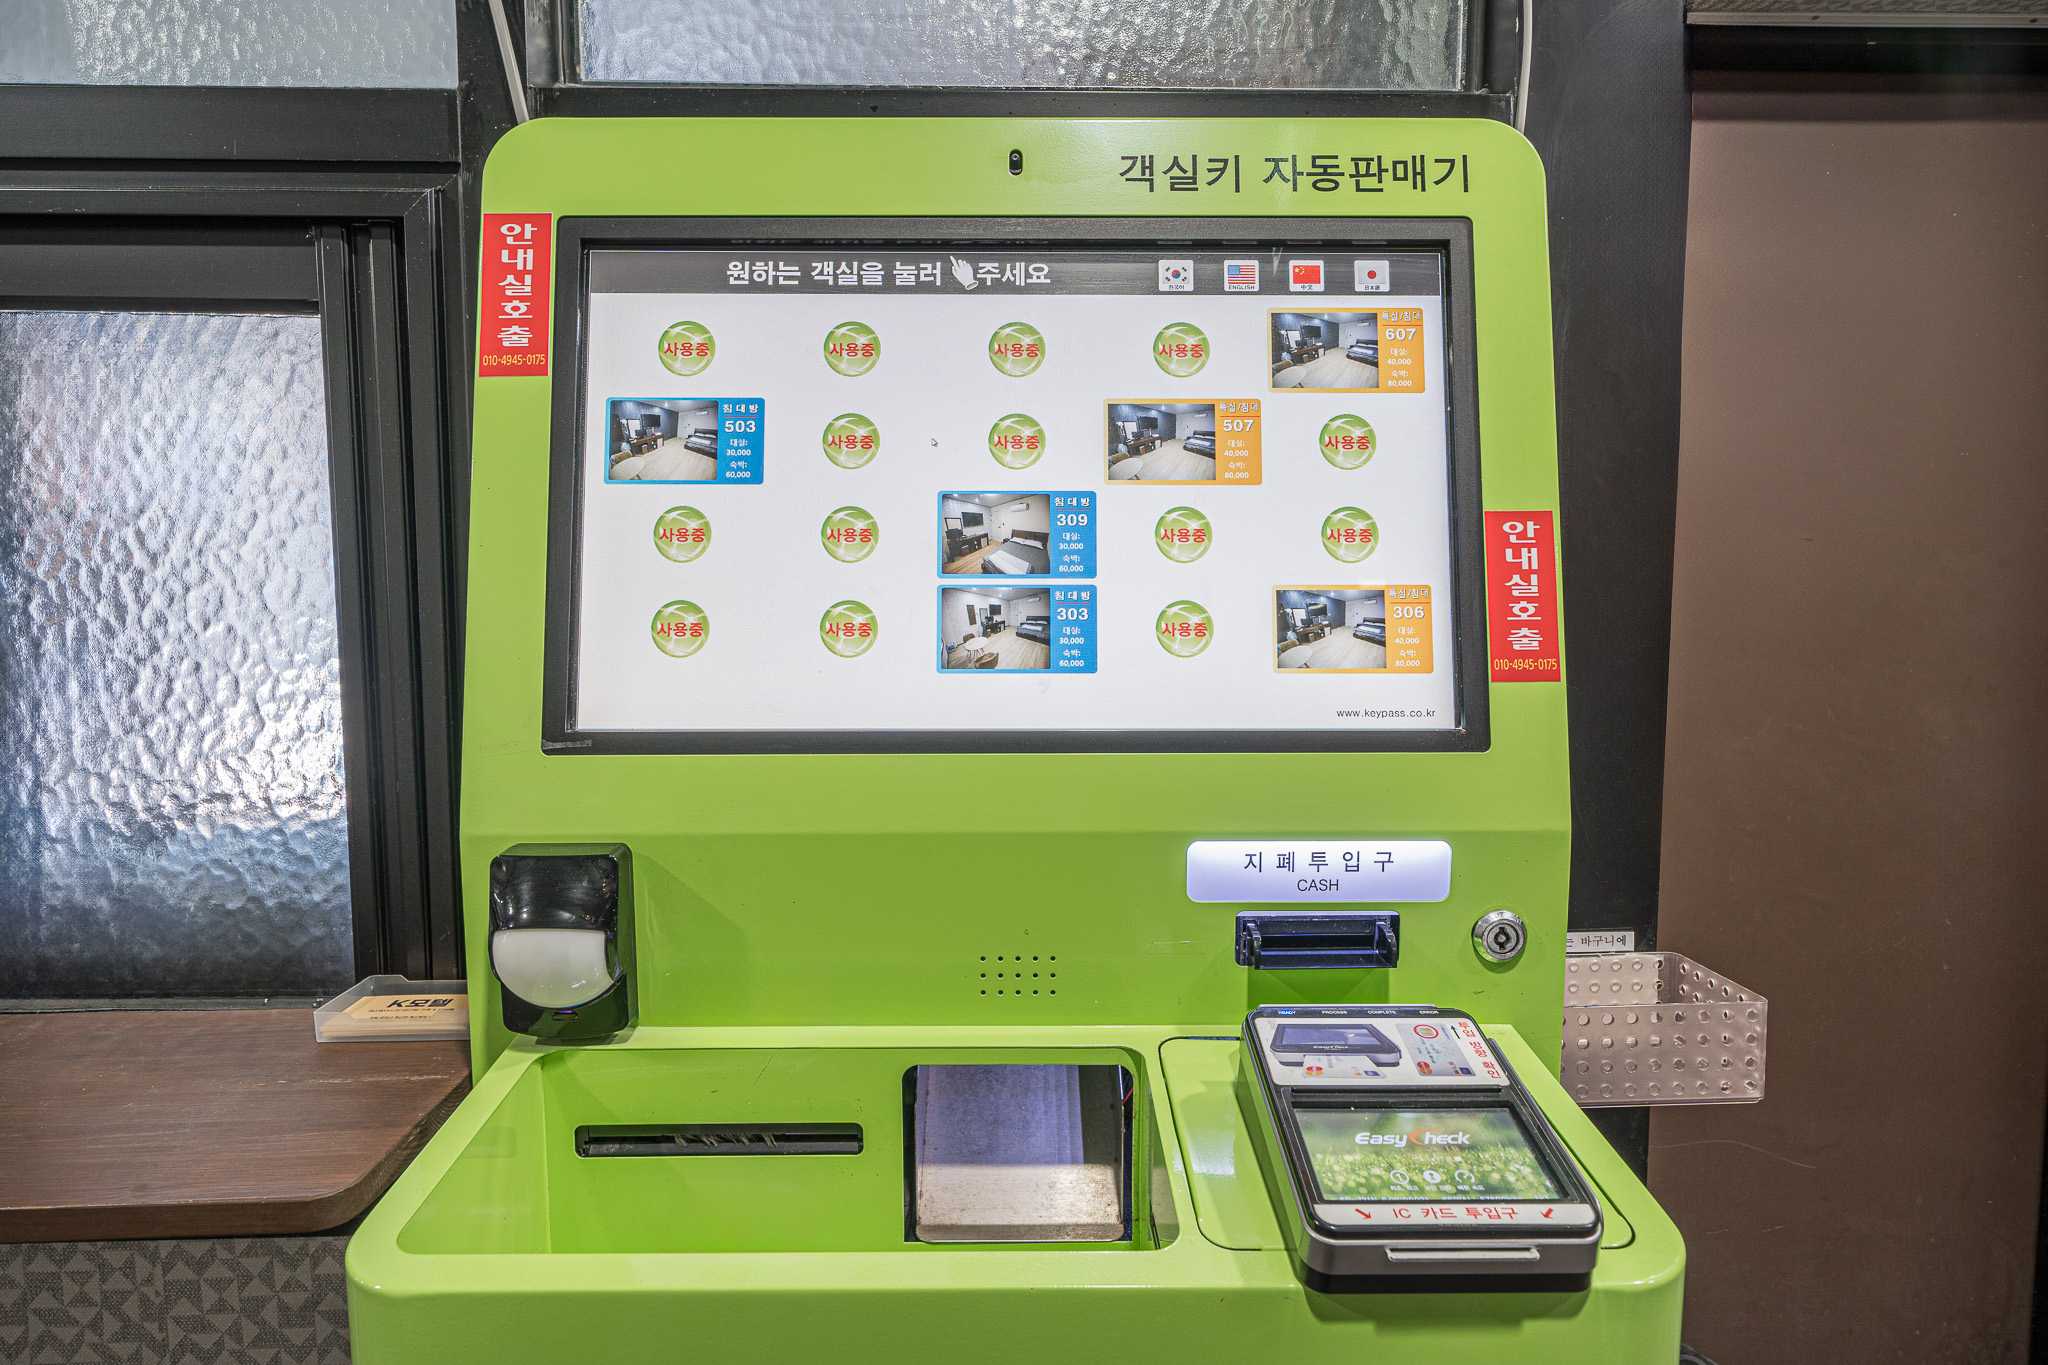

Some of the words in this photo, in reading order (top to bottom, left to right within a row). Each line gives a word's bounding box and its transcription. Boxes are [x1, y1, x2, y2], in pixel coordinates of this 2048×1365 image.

[1118, 153, 1241, 193] 객실키
[1262, 153, 1470, 193] 자동판매기
[726, 261, 801, 286] 원하는
[810, 261, 885, 286] 객실을
[893, 261, 942, 286] 눌러
[976, 261, 1051, 286] 주세요
[1385, 328, 1417, 341] 607
[663, 340, 710, 357] 사용중
[829, 341, 875, 358] 사용중
[994, 341, 1040, 358] 사용중
[1158, 342, 1204, 359] 사용중
[482, 354, 546, 366] 010-4945-0175
[724, 420, 757, 433] 503
[1222, 419, 1255, 432] 507
[827, 433, 874, 450] 사용중
[994, 433, 1040, 450] 사용중
[1324, 434, 1371, 451] 사용중
[725, 471, 751, 479] 60,000
[1056, 513, 1089, 527] 309
[659, 526, 706, 543] 사용중
[826, 526, 873, 543] 사용중
[1160, 526, 1207, 544] 사용중
[1327, 527, 1373, 544] 사용중
[1058, 542, 1084, 550] 30,000
[1058, 565, 1084, 573] 60,000
[1056, 607, 1089, 621] 303
[1392, 606, 1425, 619] 306
[657, 621, 704, 638] 사용중
[825, 621, 873, 638] 사용중
[1161, 621, 1208, 638] 사용중
[1059, 637, 1085, 645] 30,000
[1394, 637, 1420, 645] 40,000
[1058, 659, 1085, 668] 60,000
[1394, 659, 1421, 668] 80,000
[1493, 658, 1558, 671] 010-4945-0175
[1335, 708, 1436, 719] www.keypass.co.kr
[1296, 878, 1339, 892] CASH
[1580, 934, 1627, 947] 바구니에
[1354, 1128, 1472, 1148] EasyCheck
[1392, 1208, 1412, 1219] IC
[1421, 1207, 1458, 1220] 카드
[1465, 1207, 1519, 1220] 투입구
